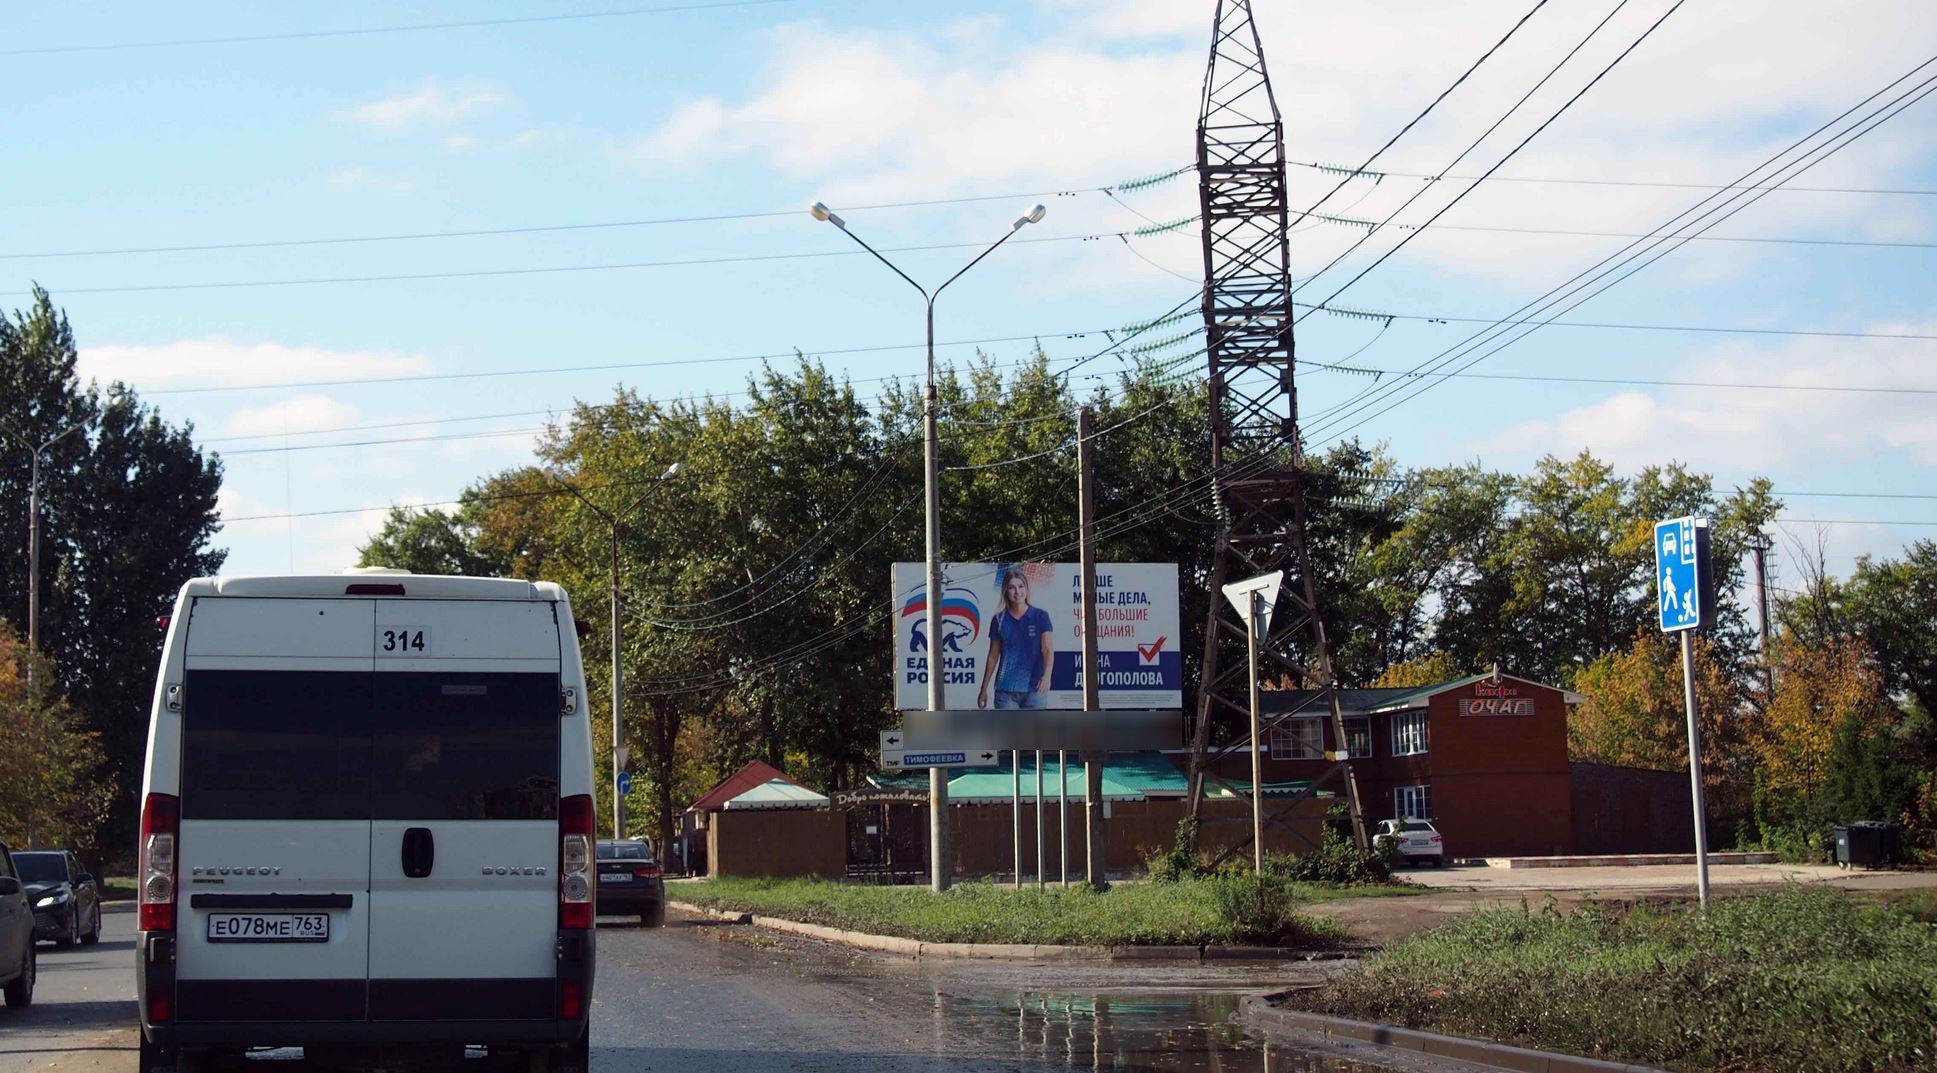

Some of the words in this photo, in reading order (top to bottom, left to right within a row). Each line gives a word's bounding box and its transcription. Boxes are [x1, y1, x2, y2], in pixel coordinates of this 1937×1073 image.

[1072, 575, 1113, 588] ЛШЕ
[1073, 592, 1115, 604] МЫЕ
[1118, 592, 1151, 606] ДЕЛА,
[1098, 608, 1149, 621] БОЛЬШИЕ
[1073, 625, 1135, 638] ОЩАНИЯ!
[383, 630, 425, 651] 314
[906, 657, 975, 670] ЕДНАЯ
[1074, 655, 1111, 668] ИНА
[906, 672, 976, 684] РОСИЯ
[1074, 672, 1164, 687] ДГОПОЛОВА
[1469, 699, 1527, 714] ОЧАГ
[905, 754, 964, 764] ТИМОФЕЕВКА
[836, 791, 867, 805] Добро
[193, 866, 282, 876] PEUGEOT
[482, 866, 546, 876] BOXER
[216, 917, 290, 935] Е078МЕ
[294, 917, 323, 930] 763
